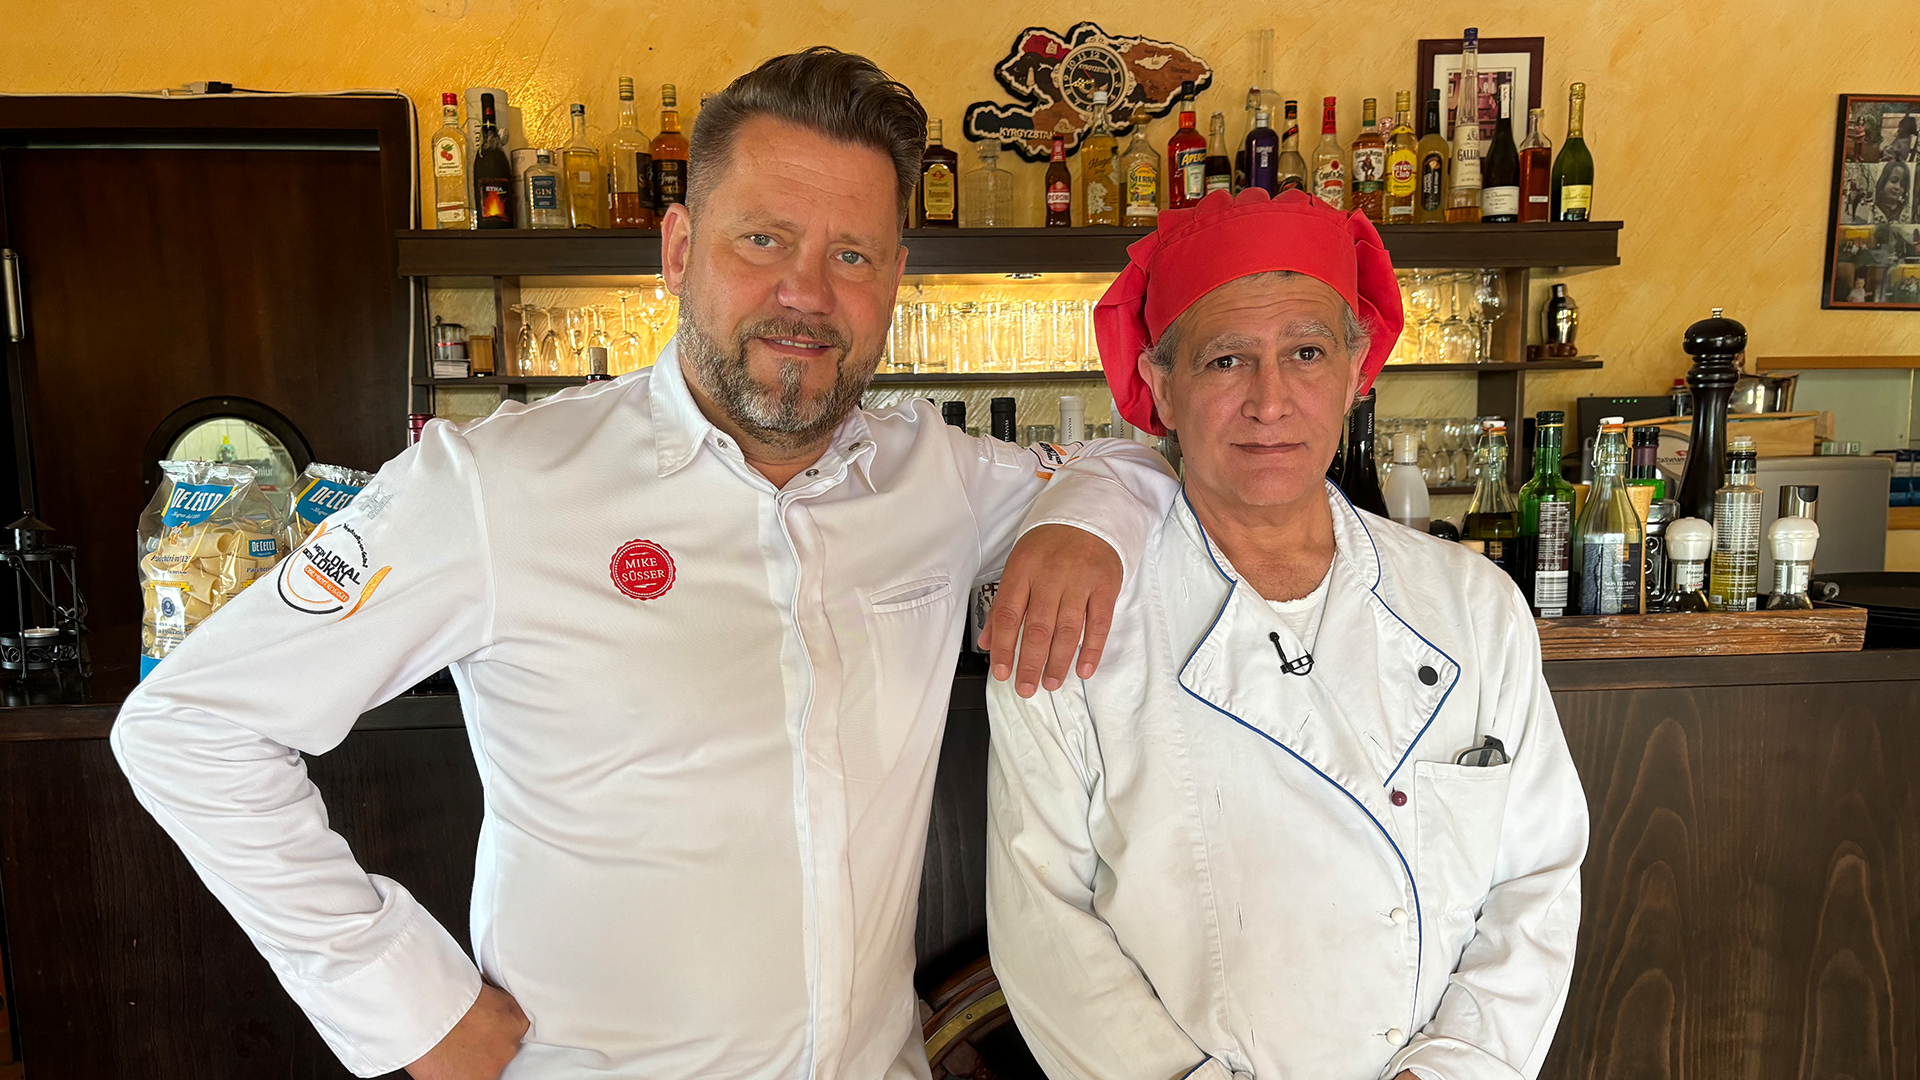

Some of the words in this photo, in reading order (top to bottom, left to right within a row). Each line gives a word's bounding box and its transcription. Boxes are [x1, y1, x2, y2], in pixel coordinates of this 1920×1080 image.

[1090, 50, 1100, 58] 12
[535, 188, 552, 196] GIN
[325, 550, 361, 585] LOKAL
[625, 557, 658, 569] MIKE
[311, 552, 345, 588] LOKAL
[621, 569, 666, 583] SÜSSER
